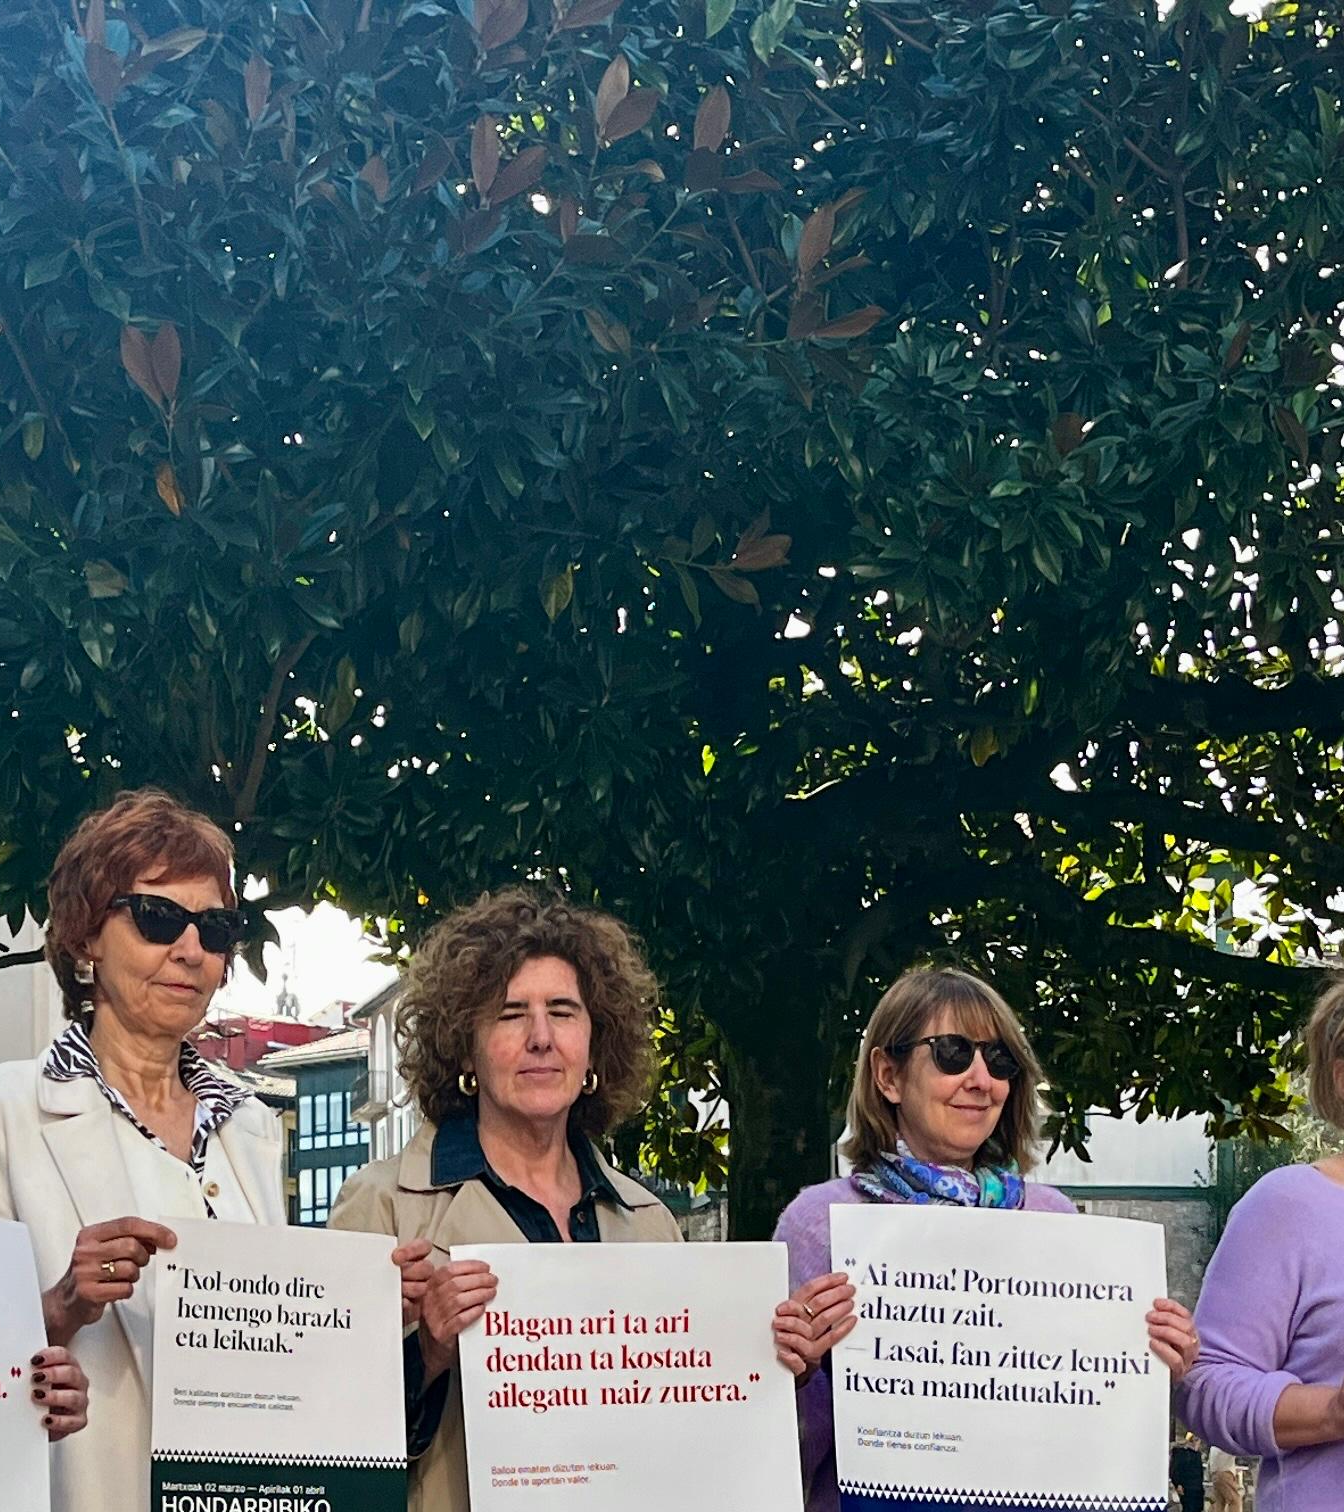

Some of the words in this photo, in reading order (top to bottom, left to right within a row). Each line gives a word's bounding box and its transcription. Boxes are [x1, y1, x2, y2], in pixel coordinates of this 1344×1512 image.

[286, 1277, 324, 1298] dire
[895, 1268, 956, 1291] ama!
[964, 1270, 1132, 1301] Portomonera
[178, 1297, 272, 1327] hemengo
[278, 1305, 350, 1329] barazki
[484, 1310, 572, 1341] Blagan
[580, 1309, 615, 1335] ari
[624, 1314, 647, 1334] ta
[655, 1309, 688, 1333] ari
[860, 1297, 944, 1323] ahaztu
[953, 1304, 1002, 1327] zait.
[176, 1331, 207, 1348] eta
[487, 1346, 582, 1372] dendan
[591, 1350, 613, 1370] ta
[622, 1345, 711, 1369] kostata
[875, 1337, 944, 1364] Lasai,
[952, 1342, 990, 1366] fan
[999, 1346, 1062, 1370] zittez
[1072, 1349, 1151, 1374] lemixi
[489, 1383, 587, 1413] ailegatu
[602, 1380, 651, 1404] naiz
[846, 1368, 914, 1395] itxera
